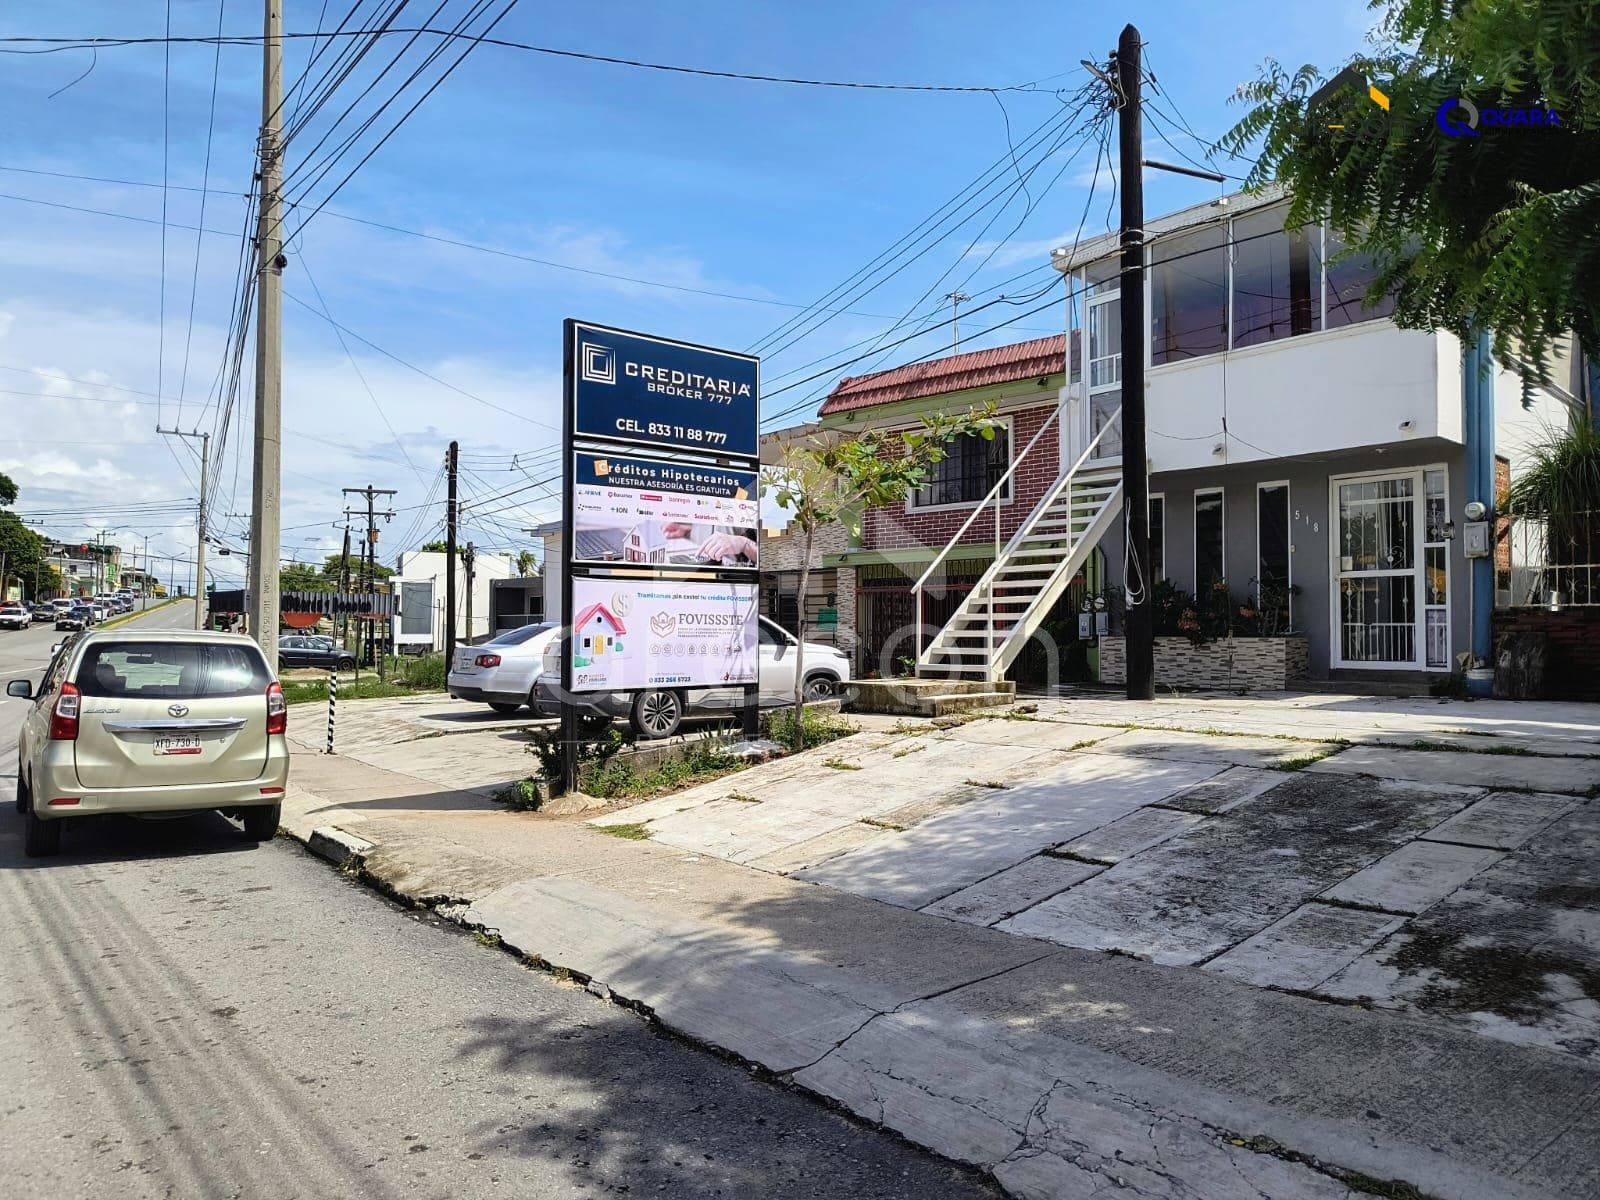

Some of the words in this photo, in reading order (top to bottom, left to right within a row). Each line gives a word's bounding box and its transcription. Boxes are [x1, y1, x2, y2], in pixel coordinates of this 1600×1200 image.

[625, 361, 750, 397] CREDITARIA
[647, 382, 703, 400] BRÓKER
[707, 392, 732, 405] 777
[615, 418, 645, 433] CEL.
[648, 422, 671, 436] 833
[674, 426, 684, 439] 11
[687, 428, 703, 441] 88
[705, 430, 727, 445] 777
[599, 462, 656, 477] Créditos
[661, 465, 740, 487] Hipotecarios
[608, 476, 645, 487] NUESTRA
[646, 480, 684, 490] ASESORÍA
[685, 484, 695, 492] ES
[696, 486, 732, 496] GRATUITA
[1295, 510, 1319, 533] 518
[678, 613, 744, 626] FOVISSSTE
